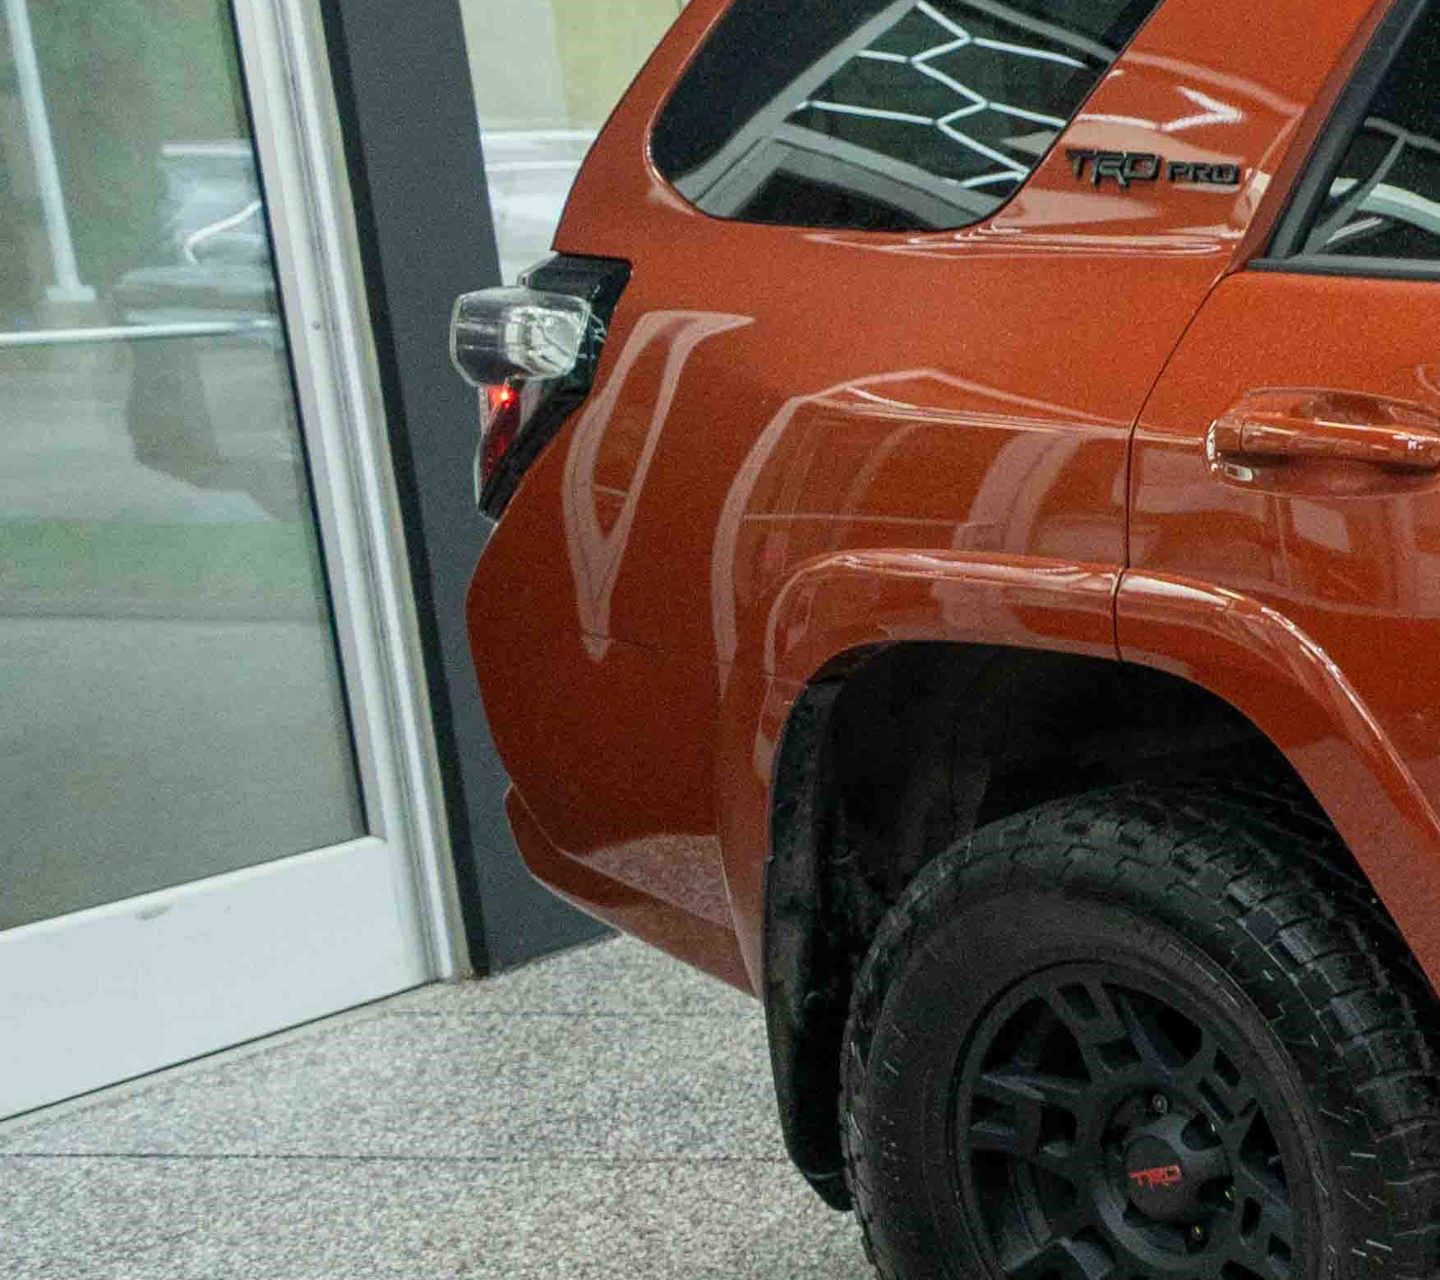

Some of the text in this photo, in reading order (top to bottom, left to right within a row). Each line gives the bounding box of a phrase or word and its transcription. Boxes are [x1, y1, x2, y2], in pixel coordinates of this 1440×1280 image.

[1066, 149, 1240, 190] TRD PRO
[1127, 1164, 1182, 1190] TRD
